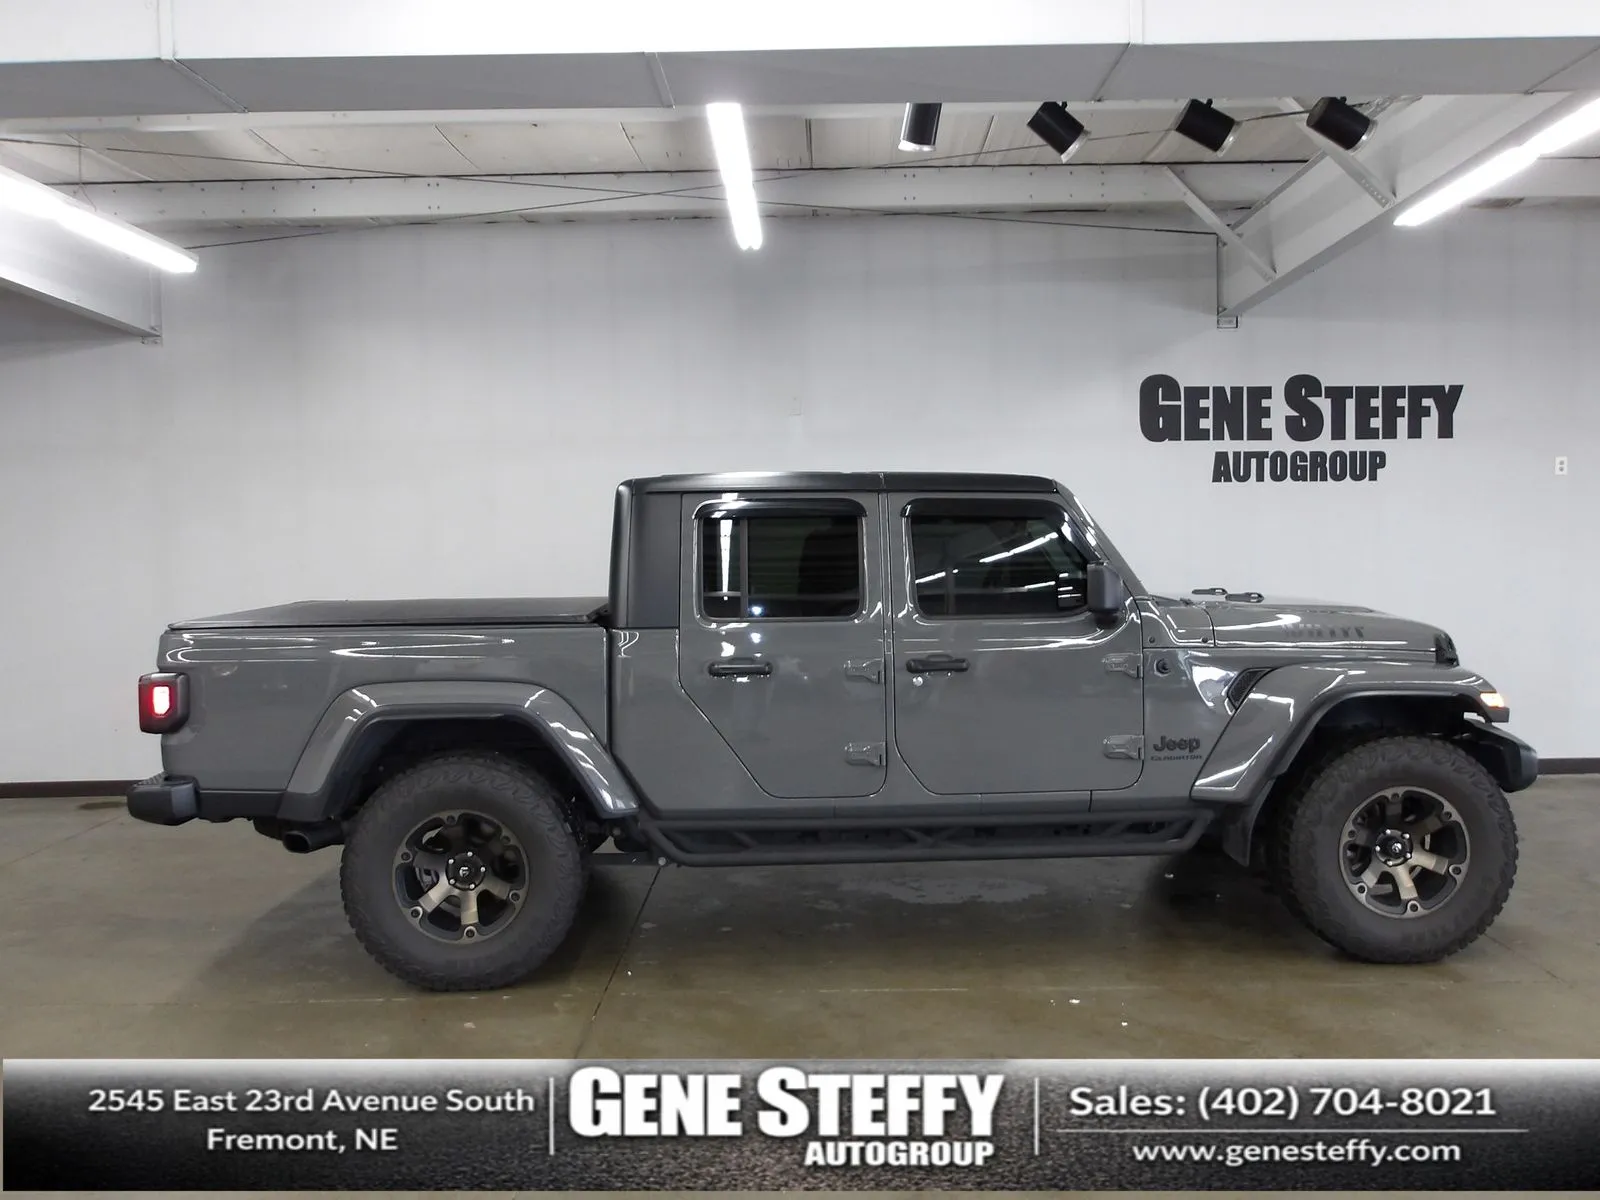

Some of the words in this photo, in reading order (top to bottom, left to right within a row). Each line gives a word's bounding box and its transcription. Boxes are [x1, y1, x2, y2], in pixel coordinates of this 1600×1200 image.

[1139, 373, 1273, 442] GENE
[1283, 373, 1464, 442] STEFFY
[1212, 450, 1387, 483] AUTOGROUP
[1153, 735, 1201, 753] Jeep
